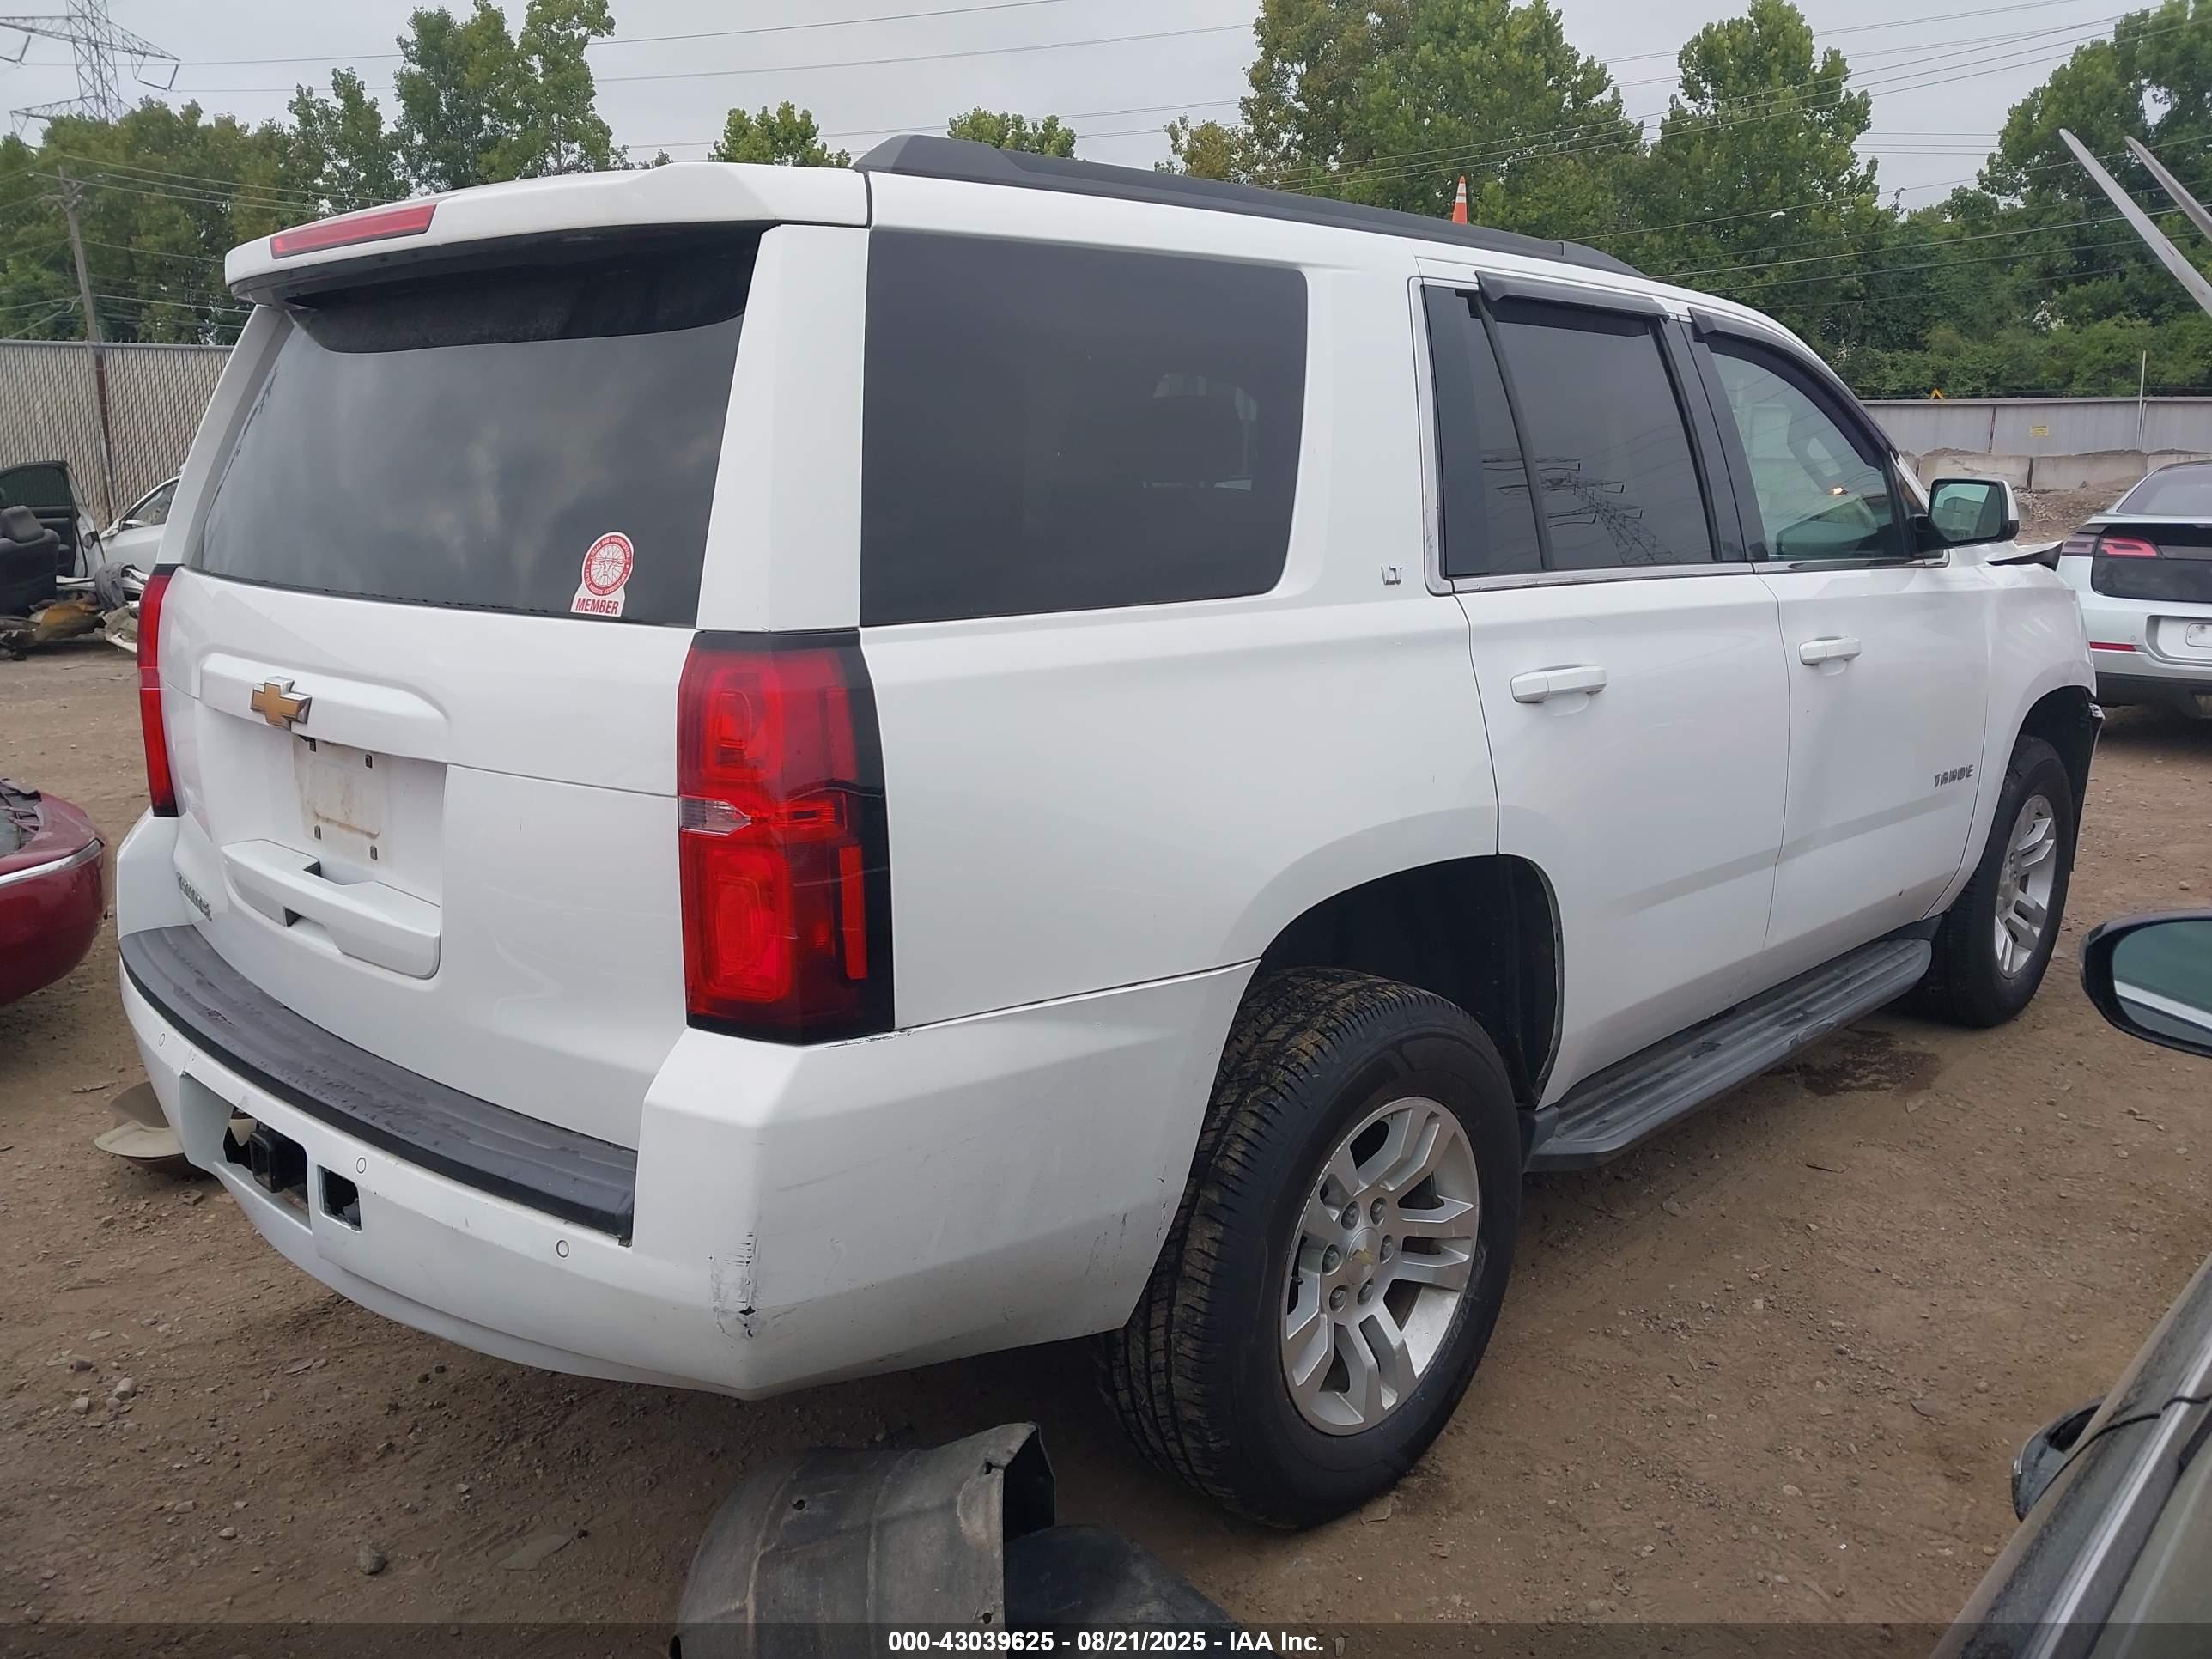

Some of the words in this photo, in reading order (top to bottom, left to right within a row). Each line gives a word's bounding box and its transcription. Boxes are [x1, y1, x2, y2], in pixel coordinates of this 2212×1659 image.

[1381, 565, 1403, 586] LT
[575, 597, 619, 615] MEMBER
[1934, 763, 1974, 788] TAHOE
